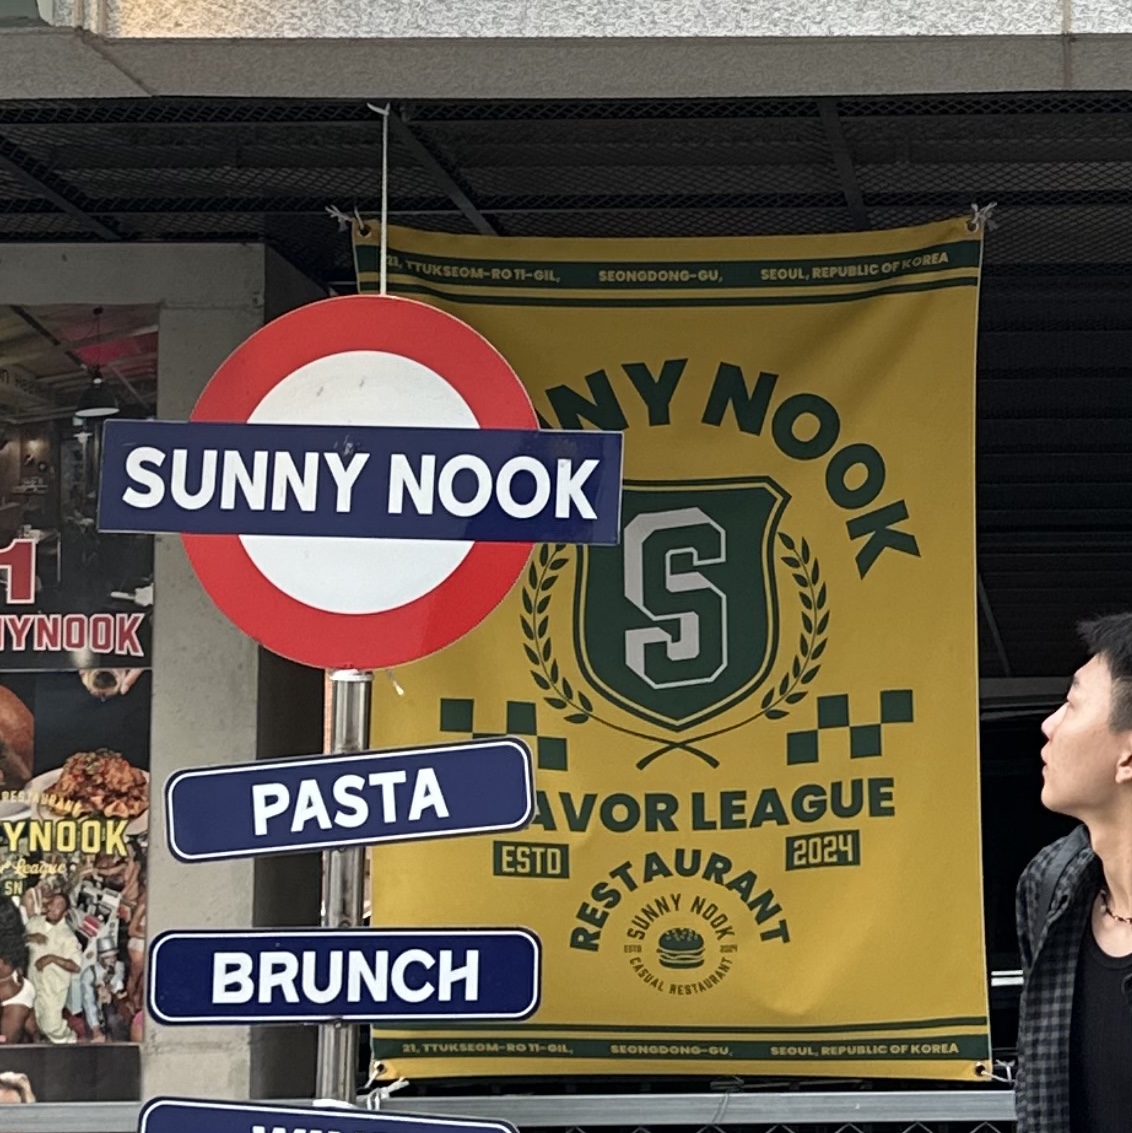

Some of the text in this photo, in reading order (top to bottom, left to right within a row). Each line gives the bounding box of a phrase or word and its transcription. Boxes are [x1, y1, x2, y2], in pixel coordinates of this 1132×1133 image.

[598, 269, 724, 283] SEONGDONG-GU,
[760, 252, 949, 282] SEOUL, REPUBLIC OF KOREA
[121, 446, 601, 521] SUNNY NOOK
[701, 361, 922, 581] NOOK
[0, 613, 145, 657] YNOOK
[251, 767, 450, 836] PASTA
[691, 777, 897, 831] LEAGUE
[500, 845, 563, 875] ESTD
[792, 833, 855, 868] 2024
[569, 848, 791, 953] RESTAURANT
[626, 893, 736, 941] SUNNY NOOK
[211, 948, 480, 1005] BRUNCH
[629, 956, 733, 996] CASUAL RESTAURANT
[421, 1042, 526, 1054] TTUKSEOM-RO
[610, 1043, 733, 1057] SEONGDONG-GU,
[769, 1042, 960, 1057] SEOUL, REPUBLIC OF KOREA
